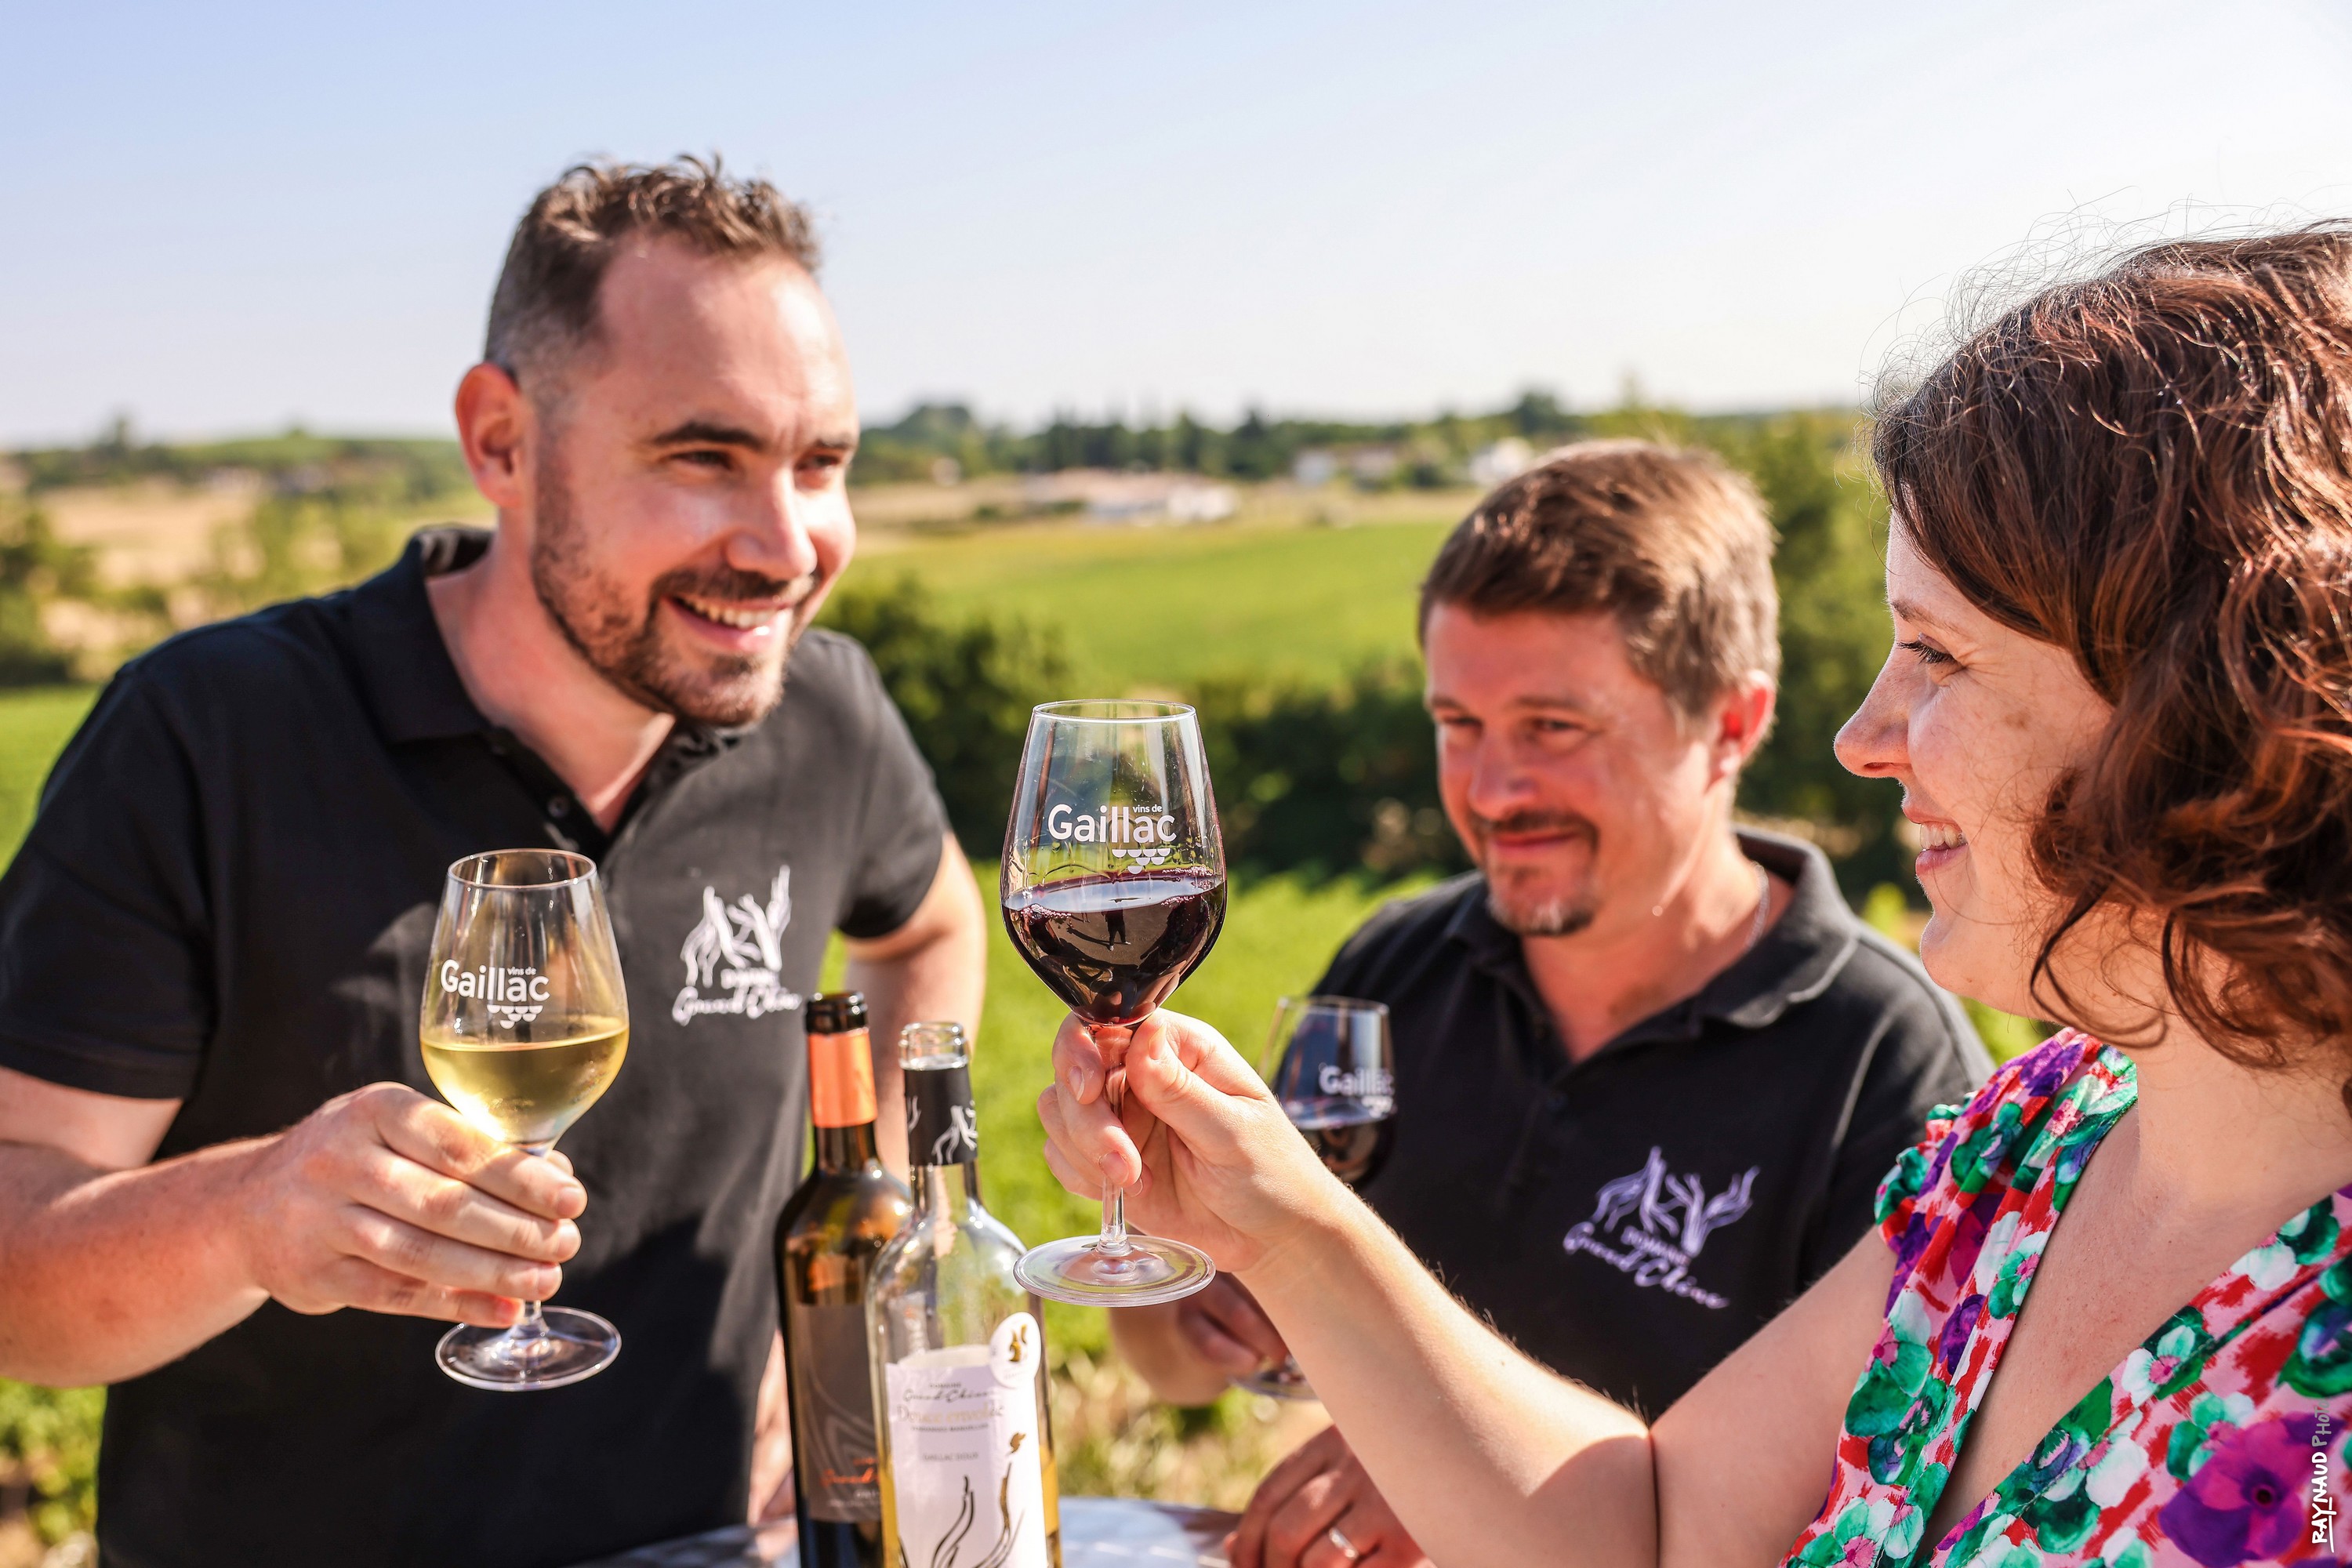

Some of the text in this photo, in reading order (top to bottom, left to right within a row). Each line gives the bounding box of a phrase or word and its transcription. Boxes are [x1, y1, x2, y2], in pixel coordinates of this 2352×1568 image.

[1152, 804, 1163, 813] de
[1047, 804, 1177, 844] Gaillac
[440, 959, 550, 1002] Gaillac
[506, 966, 537, 975] vins de
